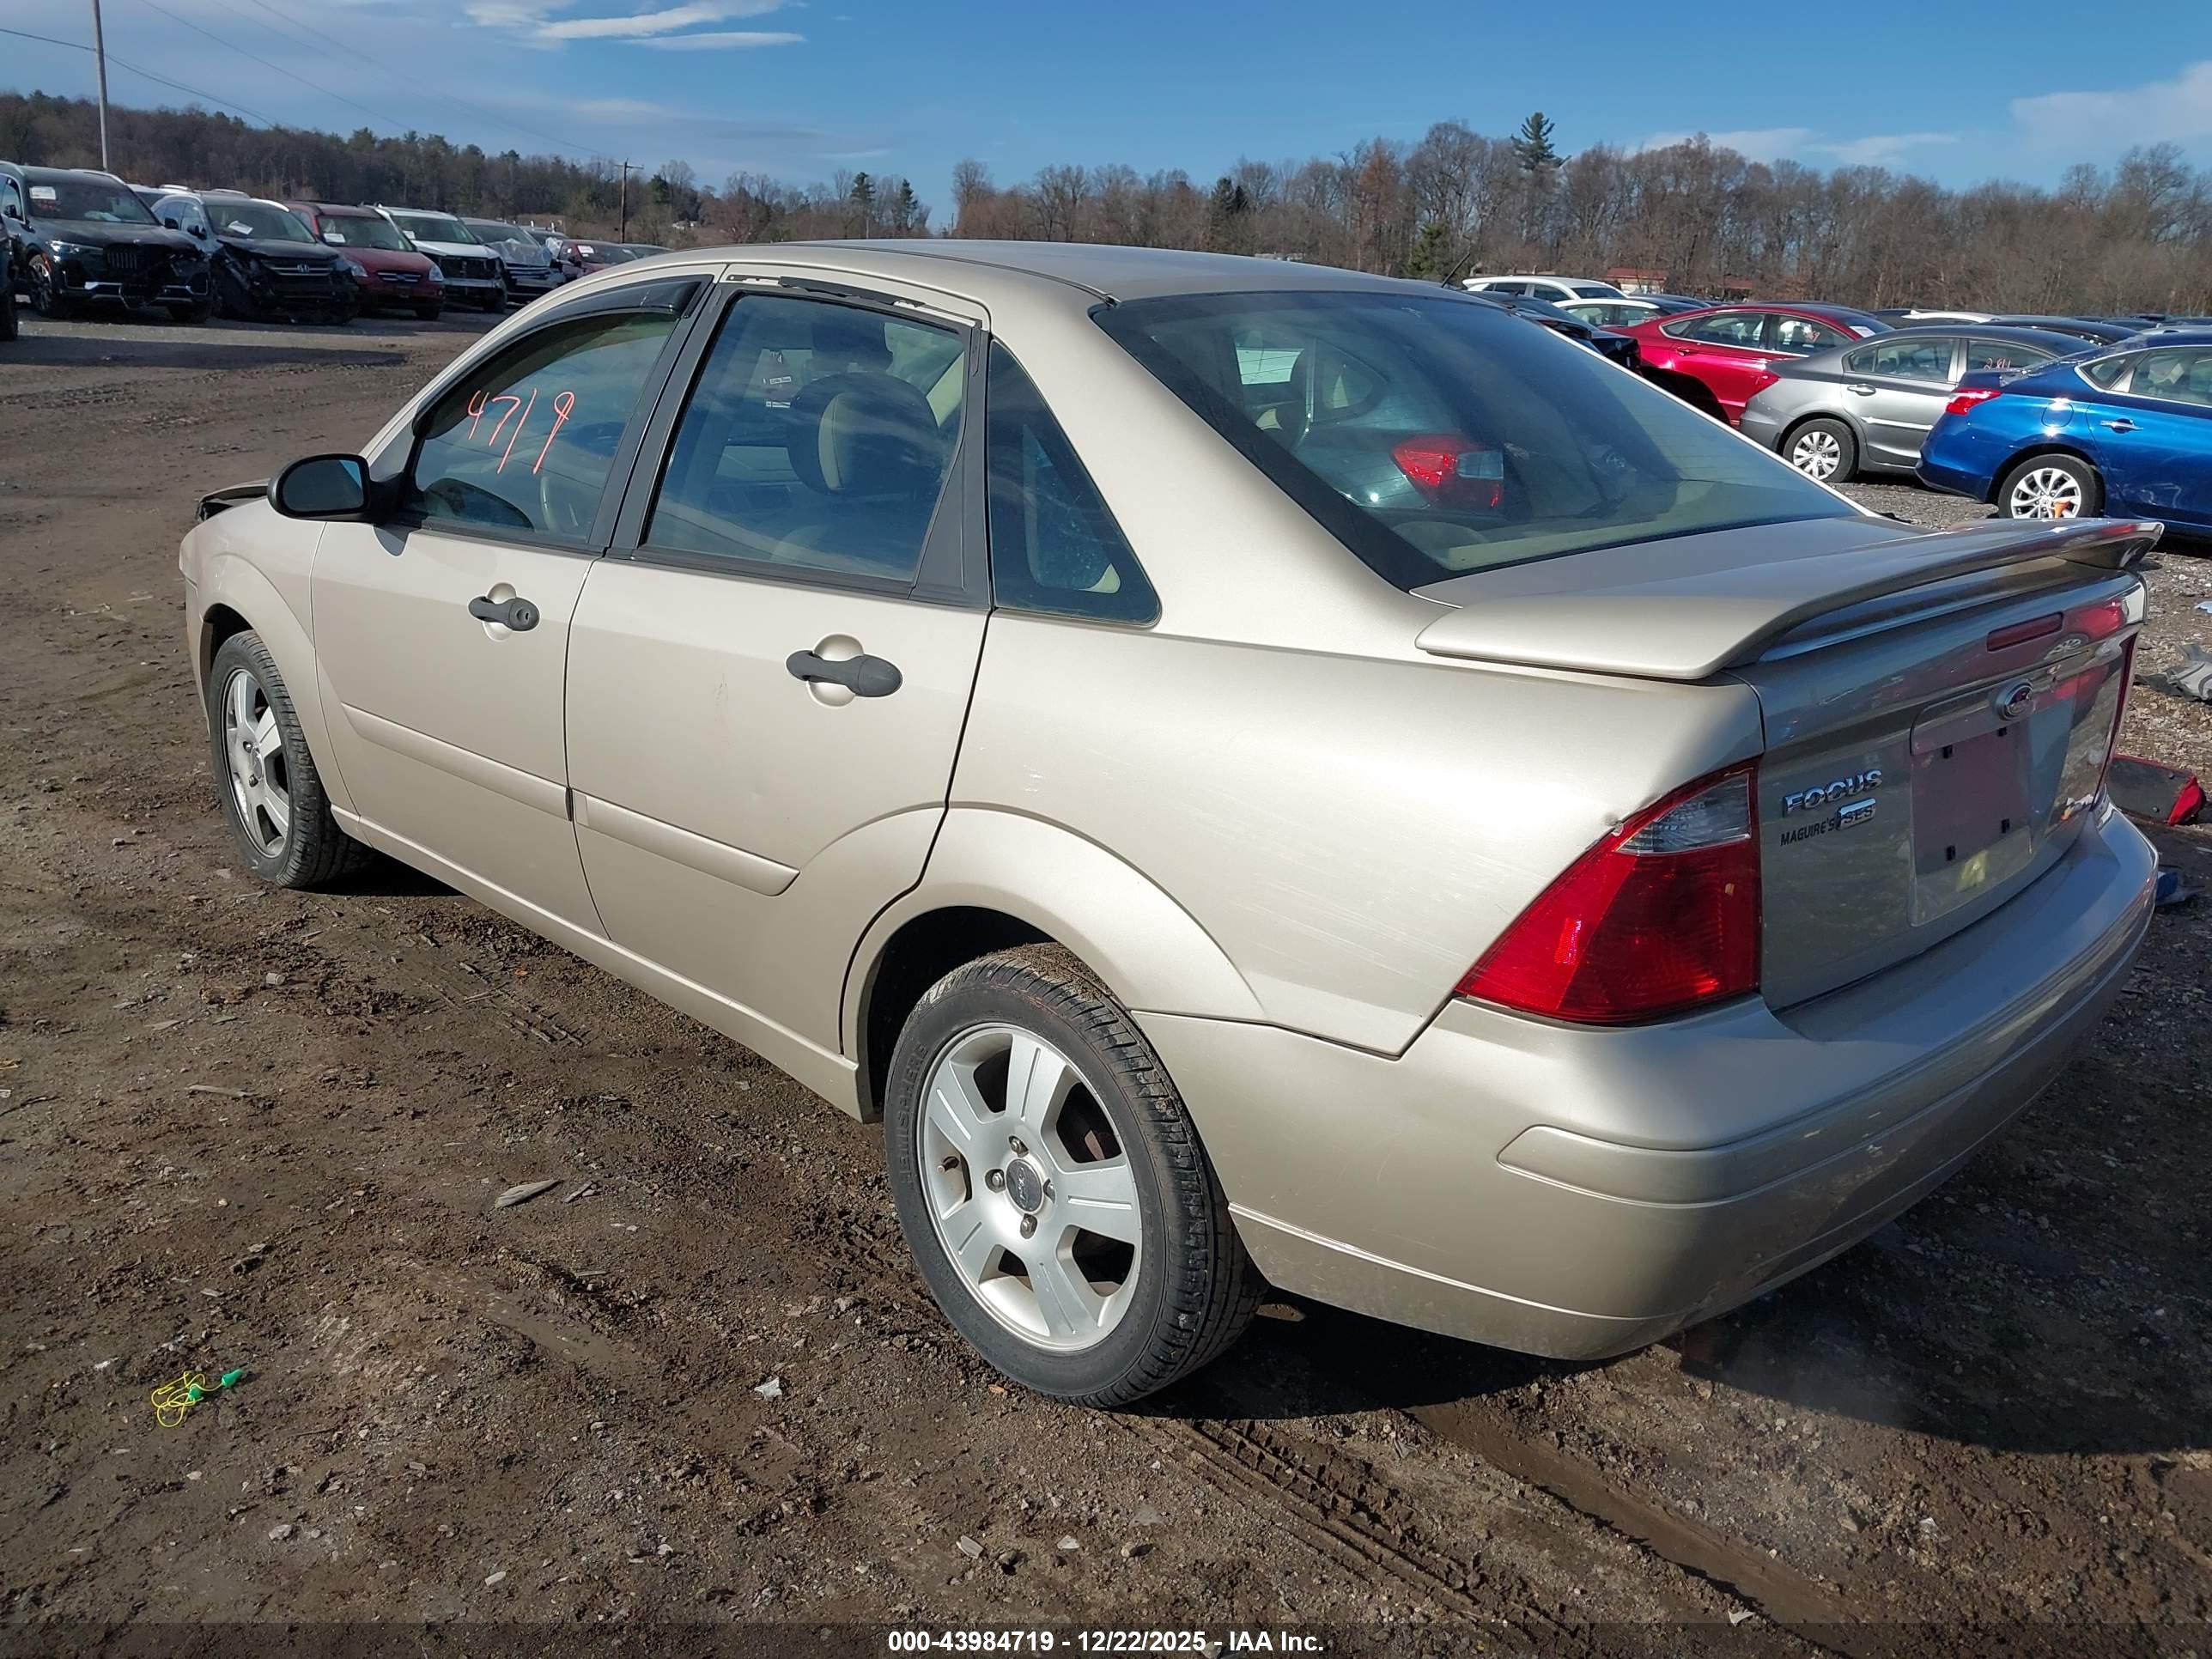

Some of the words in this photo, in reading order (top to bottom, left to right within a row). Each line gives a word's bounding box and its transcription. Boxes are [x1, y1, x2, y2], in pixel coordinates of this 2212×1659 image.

[466, 387, 576, 475] 4719
[1782, 769, 1882, 817] FOCUS
[1780, 817, 1836, 847] MAGUIRE'S
